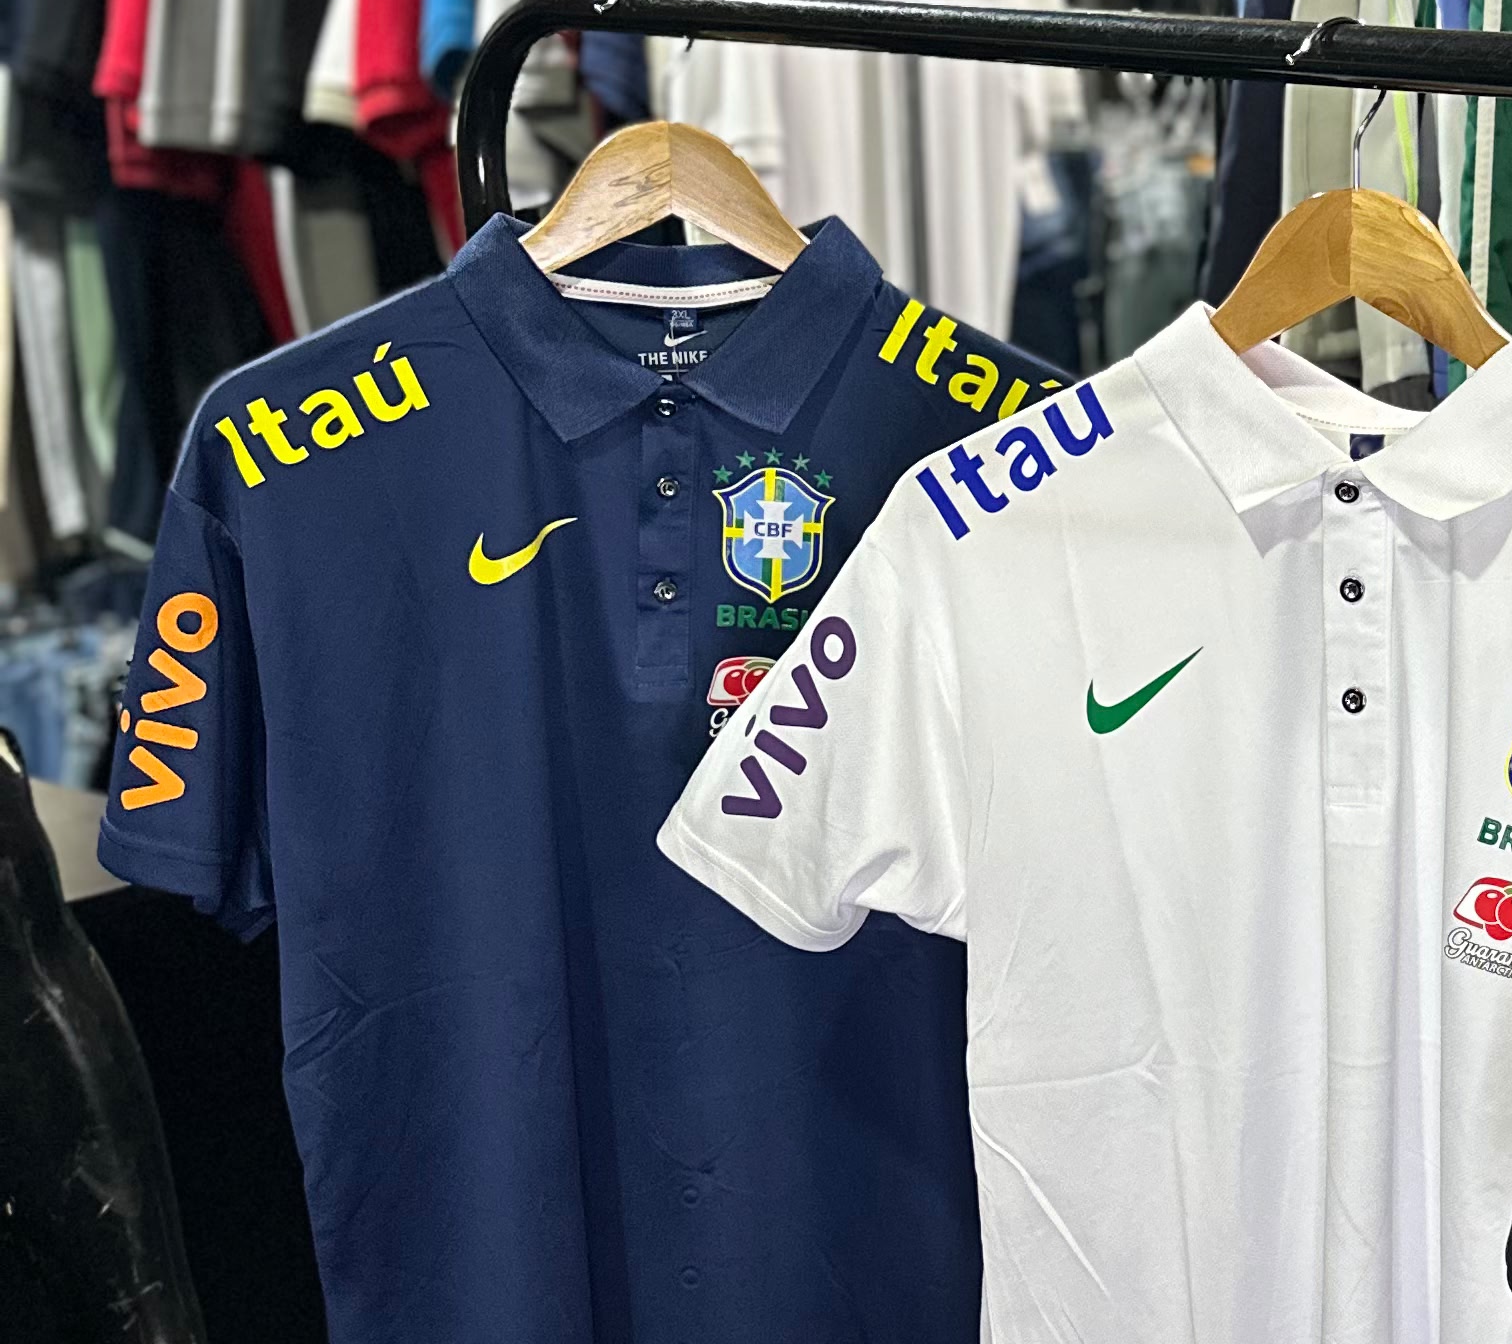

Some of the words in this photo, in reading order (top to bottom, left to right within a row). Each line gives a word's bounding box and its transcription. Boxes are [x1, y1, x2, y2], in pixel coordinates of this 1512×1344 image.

[215, 341, 430, 488] Itaú
[637, 351, 669, 366] THE
[753, 520, 794, 539] CBF
[120, 591, 219, 811] vivo
[721, 615, 857, 819] vivo
